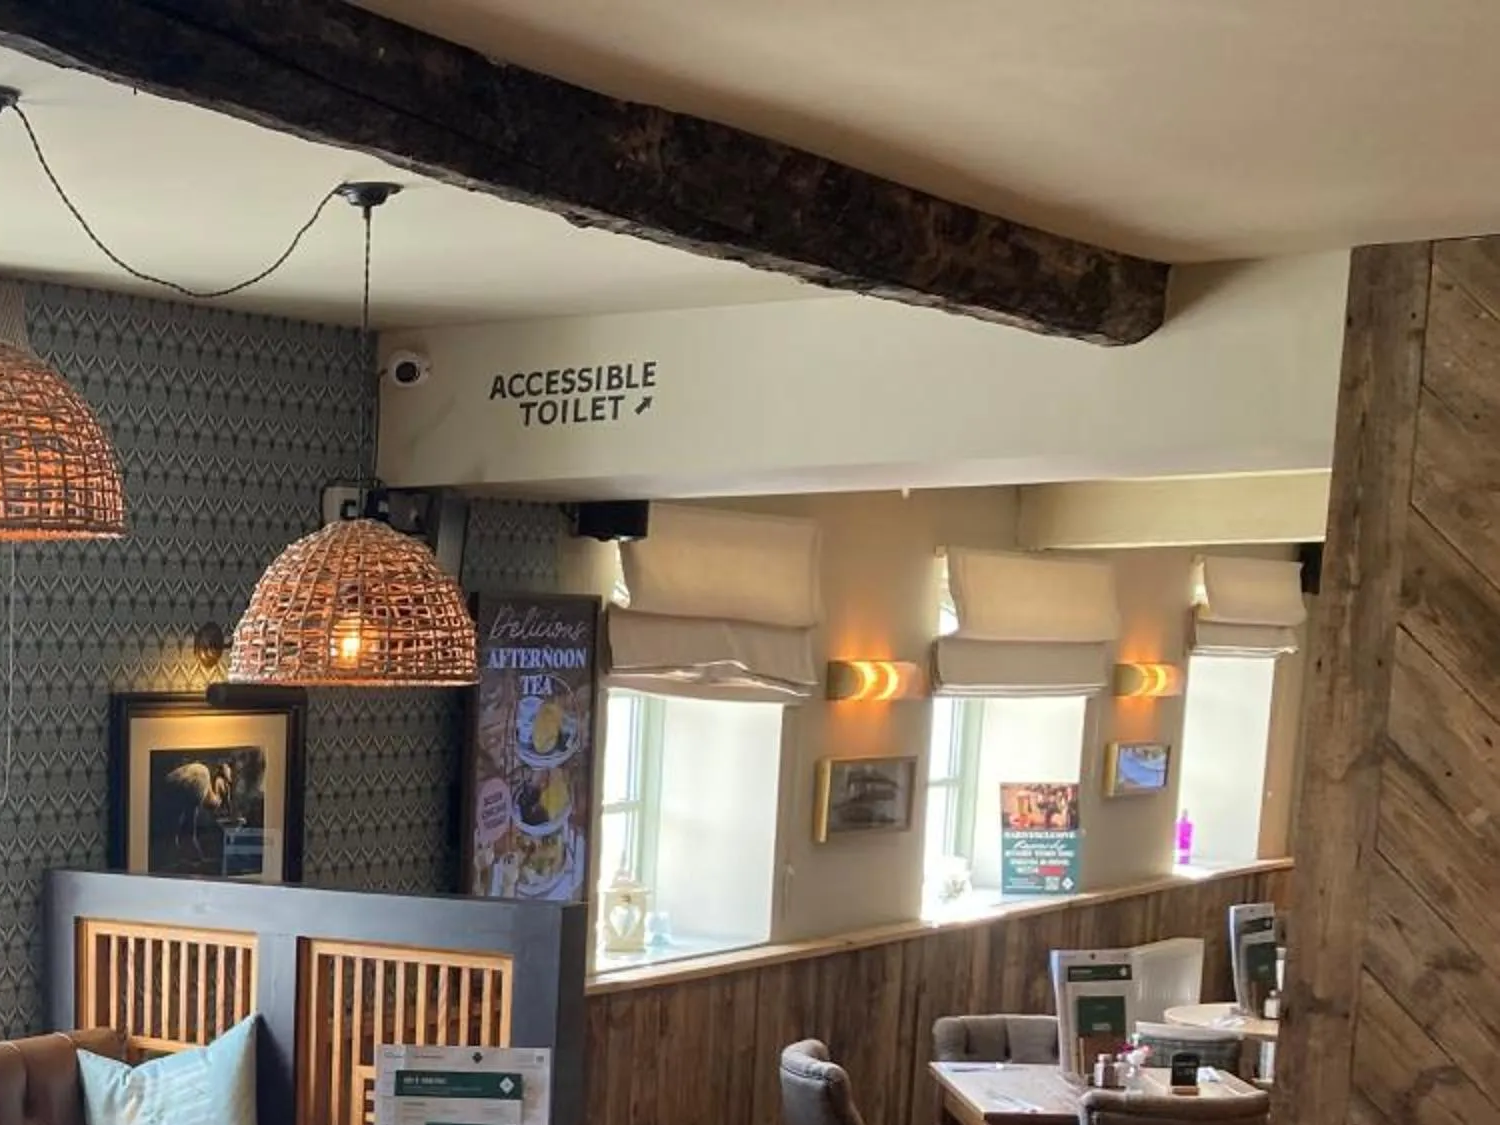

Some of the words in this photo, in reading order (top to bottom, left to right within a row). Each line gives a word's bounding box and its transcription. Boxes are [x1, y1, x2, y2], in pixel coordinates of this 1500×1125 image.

[489, 361, 657, 400] ACCESSIBLE
[519, 395, 626, 427] TOILET
[489, 605, 587, 641] Delicious
[487, 646, 587, 669] AFTERNOON
[520, 674, 554, 695] TEA
